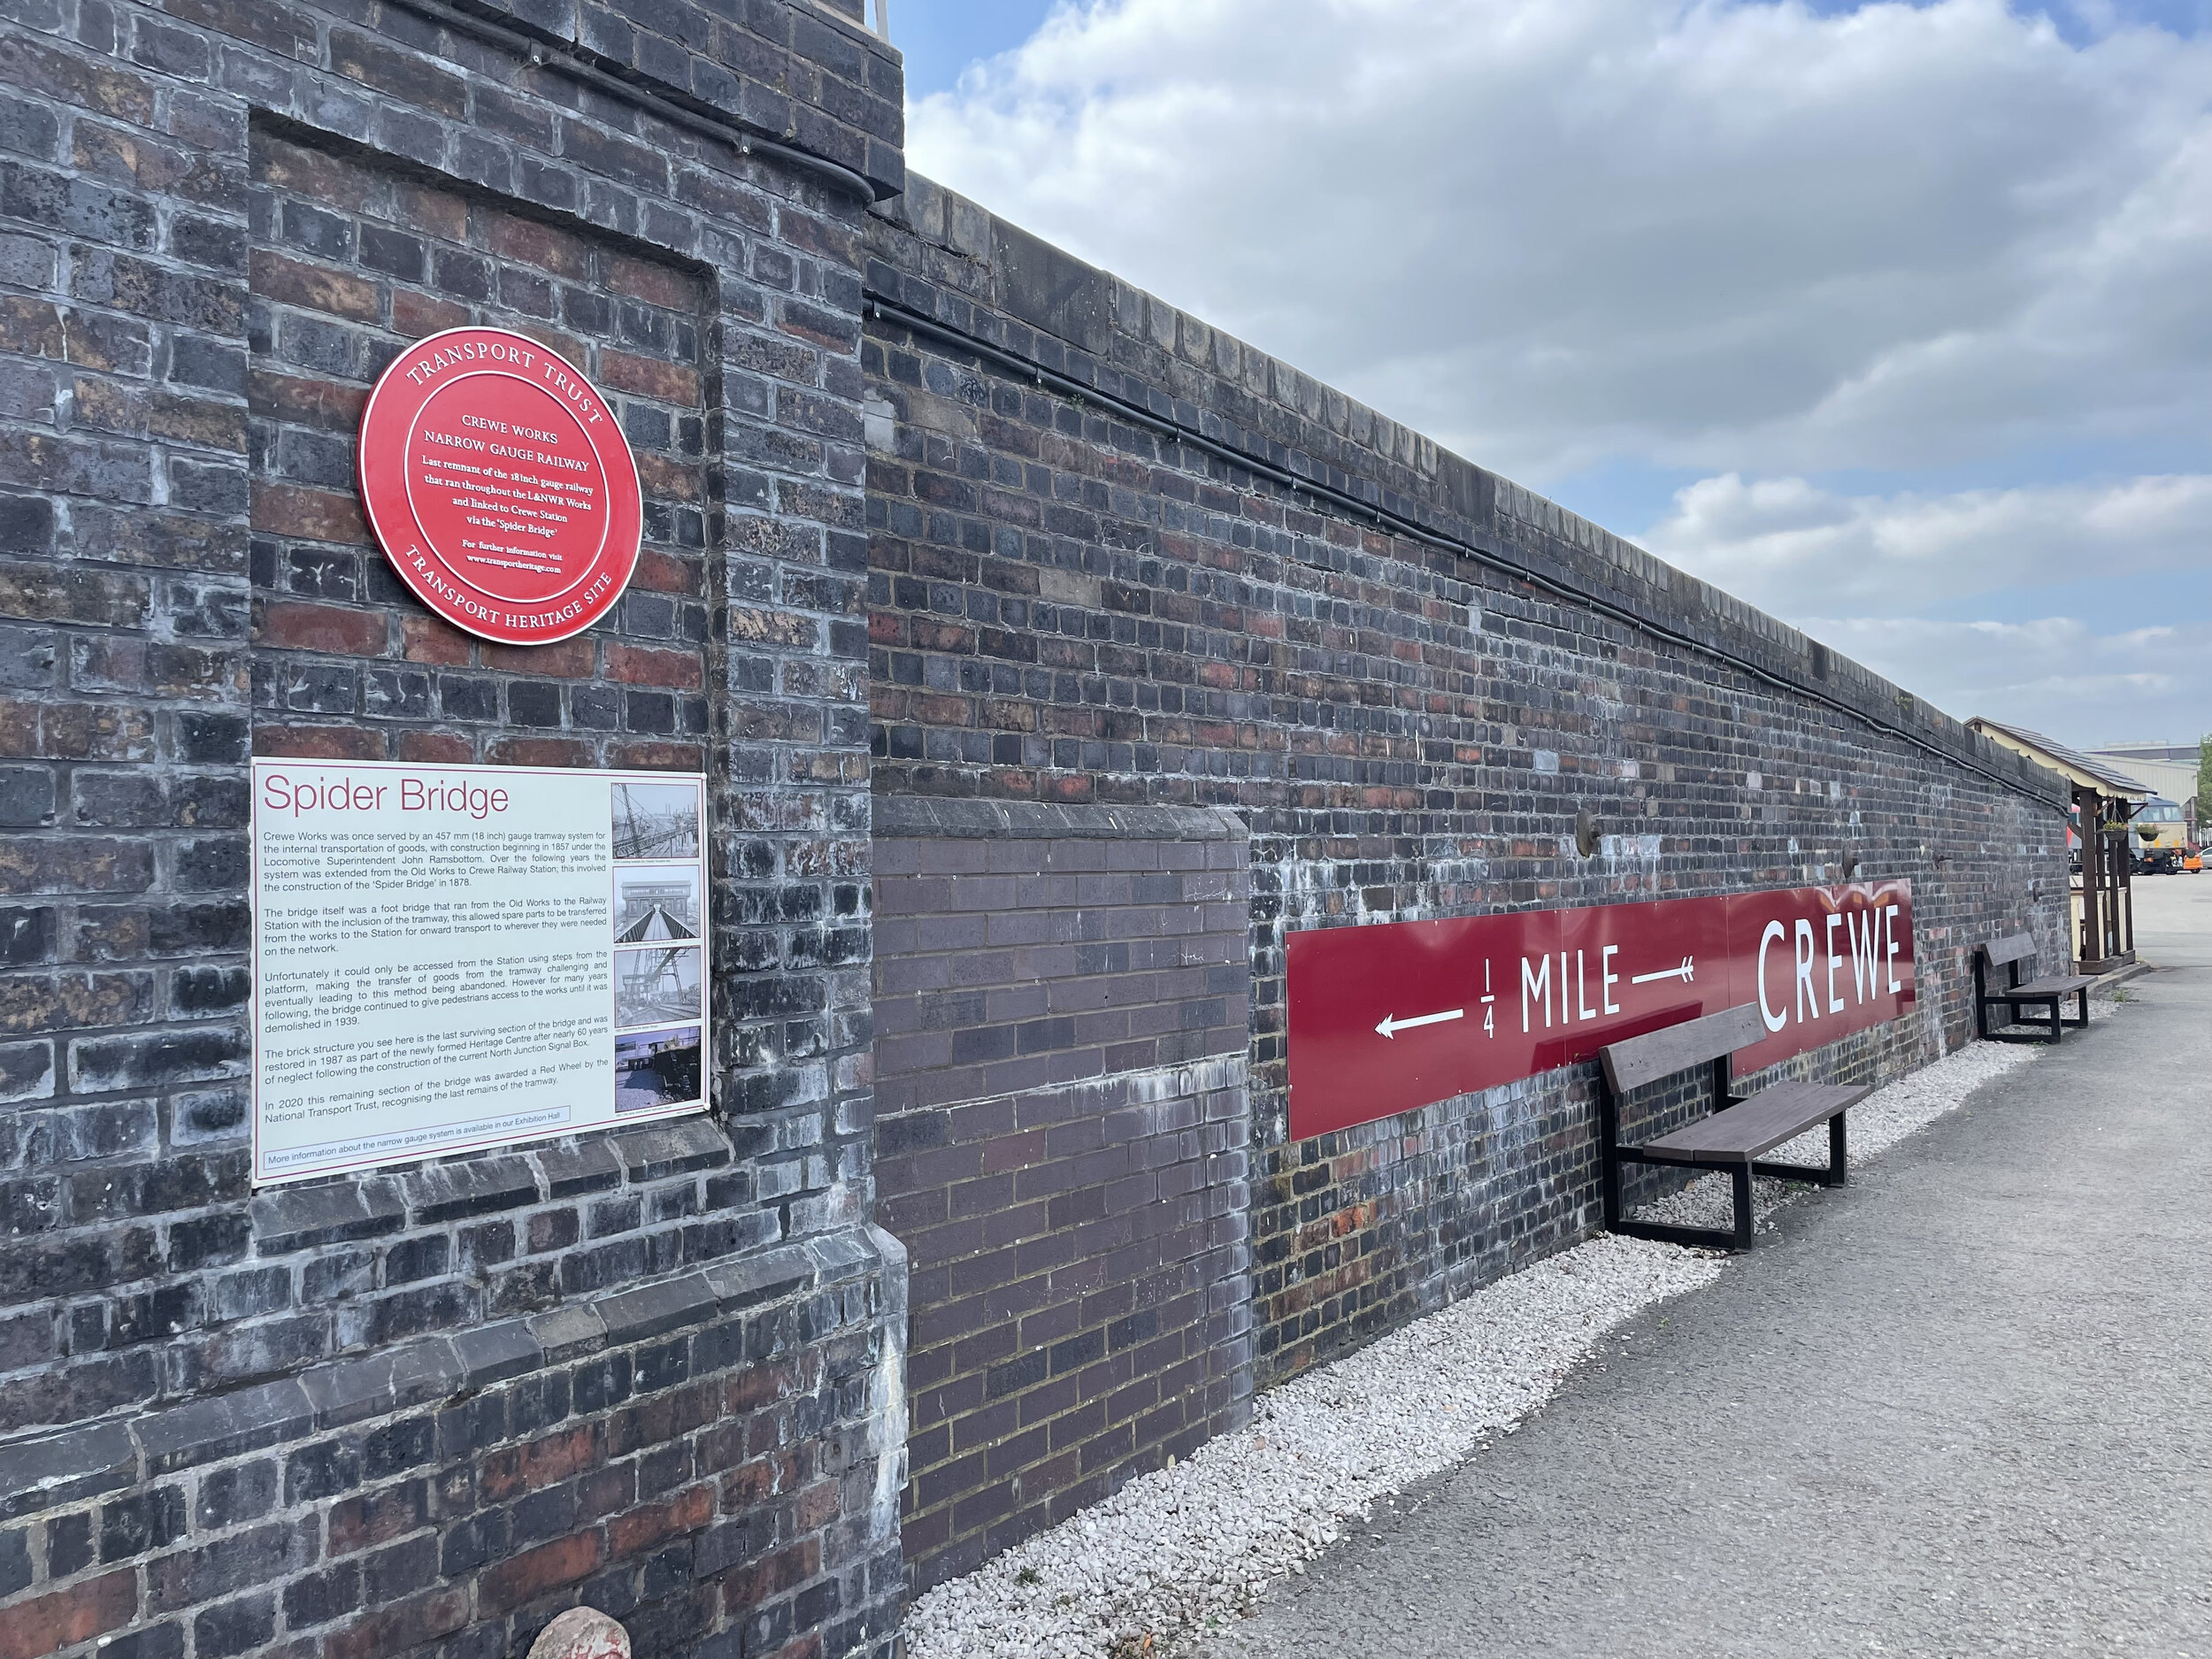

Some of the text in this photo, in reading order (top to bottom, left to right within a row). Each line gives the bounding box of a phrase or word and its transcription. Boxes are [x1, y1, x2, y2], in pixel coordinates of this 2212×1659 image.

[406, 342, 603, 424] TRANSPORT TRUST
[462, 414, 557, 444] CREWE WORKS
[424, 429, 589, 472] NARROW GAUGE RAILWAY
[421, 454, 442, 467] Last
[442, 461, 480, 474] remnant
[482, 466, 493, 476] of
[493, 468, 507, 479] the
[540, 479, 564, 490] gauge
[565, 482, 593, 496] railway
[424, 473, 591, 511] that ran throughout the L&NWR Works
[452, 496, 567, 522] and linked to Crewe Station
[465, 515, 480, 525] via
[480, 516, 496, 527] the
[462, 539, 476, 548] For
[479, 541, 504, 552] further
[505, 546, 547, 558] information
[405, 545, 612, 628] TRANSPORT HERITAGE SITE
[264, 774, 509, 819] Spider Bridge
[263, 831, 296, 841] Crewe
[297, 831, 328, 841] Works
[376, 832, 407, 841] served
[409, 832, 420, 842] by
[434, 832, 451, 841] 457
[472, 832, 485, 841] (18
[487, 832, 506, 841] inch)
[508, 833, 533, 842] gauge
[534, 832, 566, 841] tramway
[567, 832, 594, 841] system
[595, 831, 606, 840] for
[264, 844, 280, 854] the
[282, 844, 318, 854] internal
[320, 844, 384, 855] transportation
[386, 843, 396, 853] of
[397, 843, 428, 855] goods,
[430, 843, 449, 852] with
[449, 843, 501, 852] construction
[502, 842, 541, 854] beginning
[551, 842, 570, 851] 1857
[572, 842, 593, 851] under
[264, 857, 320, 867] Locomotive
[326, 856, 396, 867] Superintendent
[401, 856, 424, 864] John
[429, 855, 485, 864] Ramsbottom.
[489, 854, 510, 864] Over
[514, 854, 527, 863] the
[532, 854, 565, 864] following
[570, 855, 590, 864] years
[264, 871, 299, 881] system
[324, 868, 368, 879] extended
[370, 868, 391, 877] from
[394, 868, 408, 877] the
[411, 867, 426, 876] Old
[428, 866, 456, 876] Works
[469, 865, 495, 875] Crewe
[497, 865, 527, 876] Railway
[529, 864, 559, 874] Station;
[576, 864, 606, 872] involved
[264, 883, 280, 892] the
[282, 882, 342, 892] construction
[343, 880, 353, 890] of
[355, 880, 370, 889] the
[449, 878, 472, 887] 1878.
[1520, 944, 1620, 1033] MILE
[1757, 904, 1902, 1033] CREWE
[265, 1074, 275, 1085] of
[277, 1071, 313, 1085] neglect
[315, 1067, 357, 1079] following
[359, 1064, 374, 1073] the
[376, 1058, 431, 1071] construction
[433, 1056, 442, 1065] of
[443, 1055, 457, 1064] the
[458, 1050, 488, 1062] current
[489, 1048, 512, 1058] North
[513, 1045, 547, 1056] Junction
[548, 1041, 572, 1052] Signal
[265, 1102, 274, 1110] In
[279, 1097, 303, 1110] 2020
[307, 1095, 326, 1105] this
[329, 1089, 374, 1102] remaining
[378, 1085, 411, 1096] section
[414, 1081, 424, 1091] of
[426, 1080, 441, 1089] the
[444, 1077, 472, 1087] bridge
[474, 1074, 491, 1083] was
[494, 1068, 528, 1080] awarded
[540, 1064, 556, 1074] Red
[558, 1061, 581, 1071] Wheel
[584, 1061, 594, 1070] by
[596, 1058, 609, 1067] the
[265, 1110, 305, 1124] National
[307, 1103, 352, 1118] Transport
[354, 1101, 380, 1111] Trust,
[381, 1094, 432, 1108] recognising
[434, 1091, 448, 1101] the
[449, 1088, 465, 1098] last
[466, 1085, 499, 1095] remains
[500, 1081, 509, 1091] of
[510, 1081, 524, 1090] the
[268, 1156, 290, 1164] More
[291, 1148, 337, 1161] information
[338, 1143, 361, 1154] about
[376, 1138, 403, 1148] narrow
[403, 1133, 427, 1145] gauge
[428, 1129, 455, 1141] system
[463, 1123, 494, 1133] available
[514, 1115, 547, 1125] Exhibition
[548, 1111, 560, 1120] Hall
